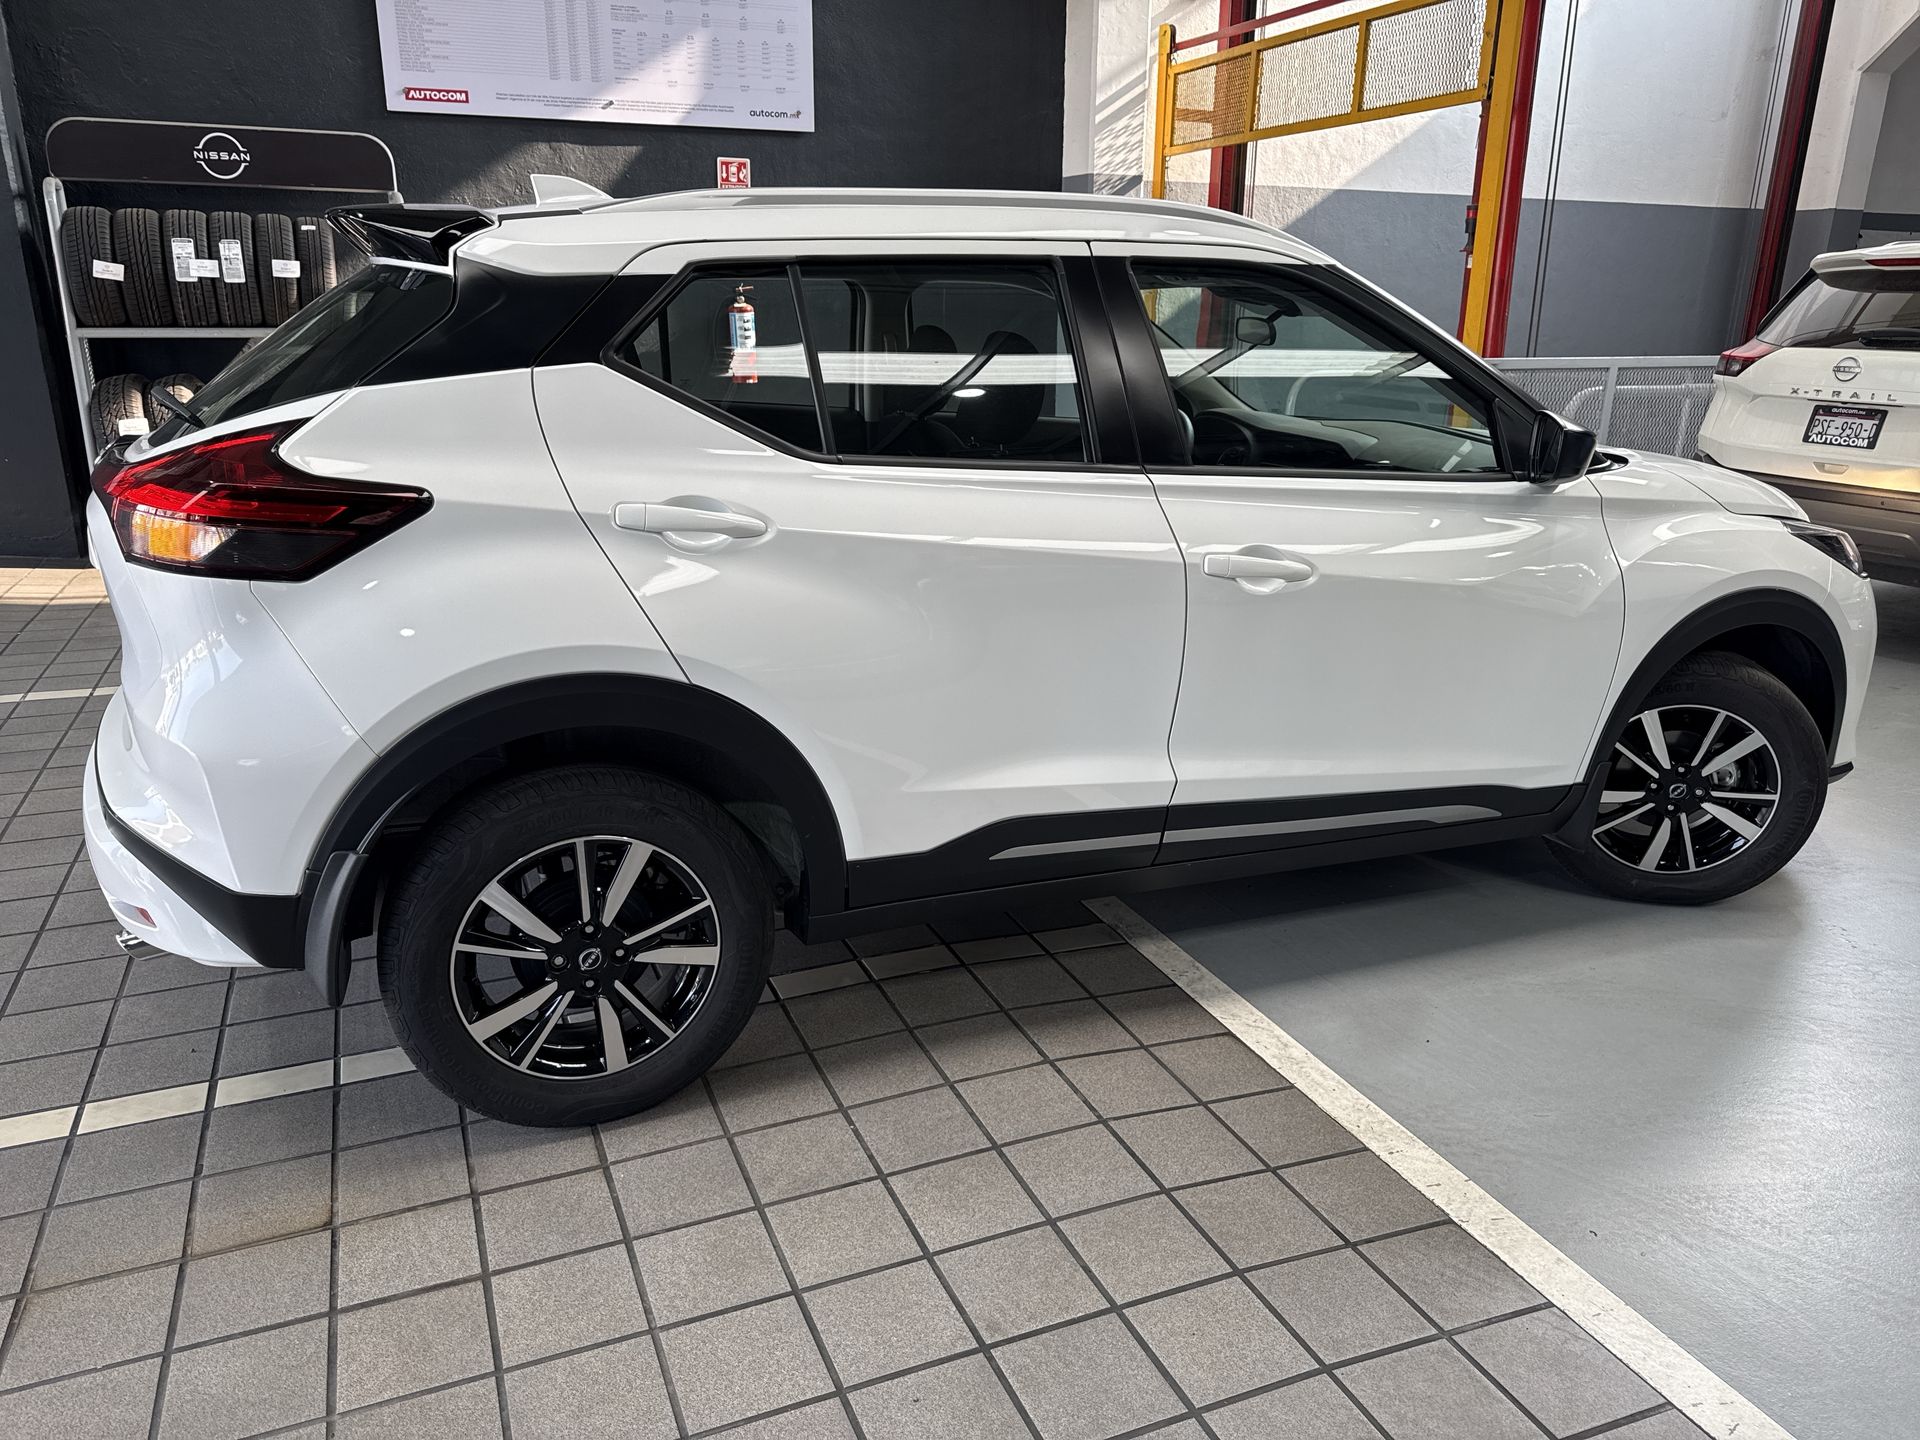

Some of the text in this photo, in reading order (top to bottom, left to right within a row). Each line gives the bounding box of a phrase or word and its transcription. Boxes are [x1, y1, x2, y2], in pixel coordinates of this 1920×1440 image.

[408, 90, 466, 101] AUTOCOM
[193, 150, 250, 162] NISSAN
[1791, 388, 1897, 401] X-TRAIL
[1809, 434, 1868, 447] AUTOCOM
